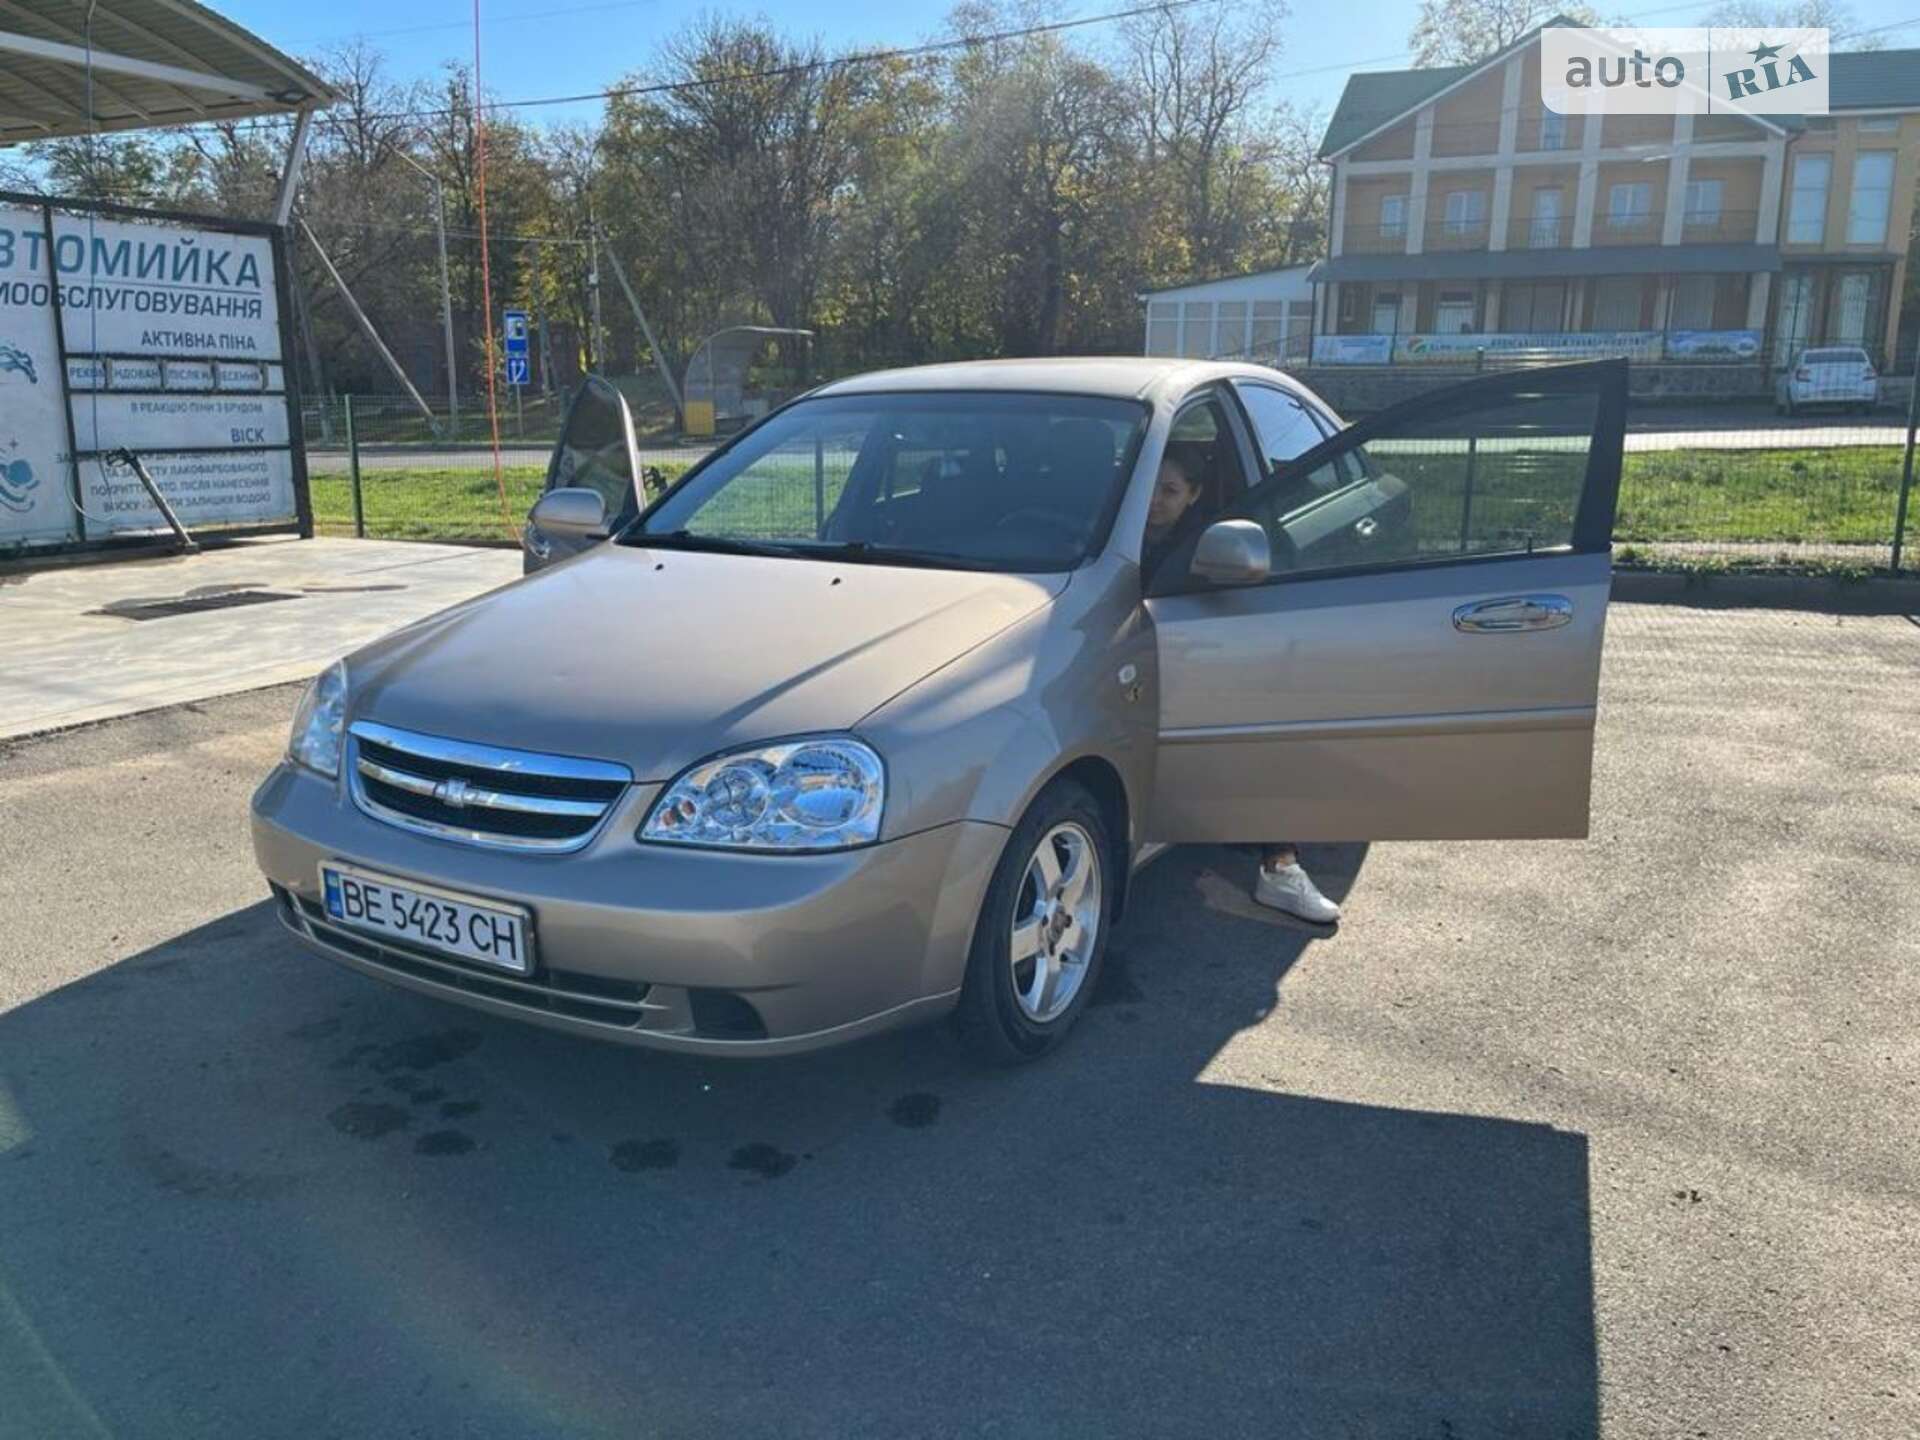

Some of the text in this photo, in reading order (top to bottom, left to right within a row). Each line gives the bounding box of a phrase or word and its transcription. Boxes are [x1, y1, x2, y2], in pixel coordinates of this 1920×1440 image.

[141, 330, 256, 350] АКТИВНА ПІНА
[231, 427, 264, 443] ВІСК
[343, 879, 516, 960] BE 5423 CH
